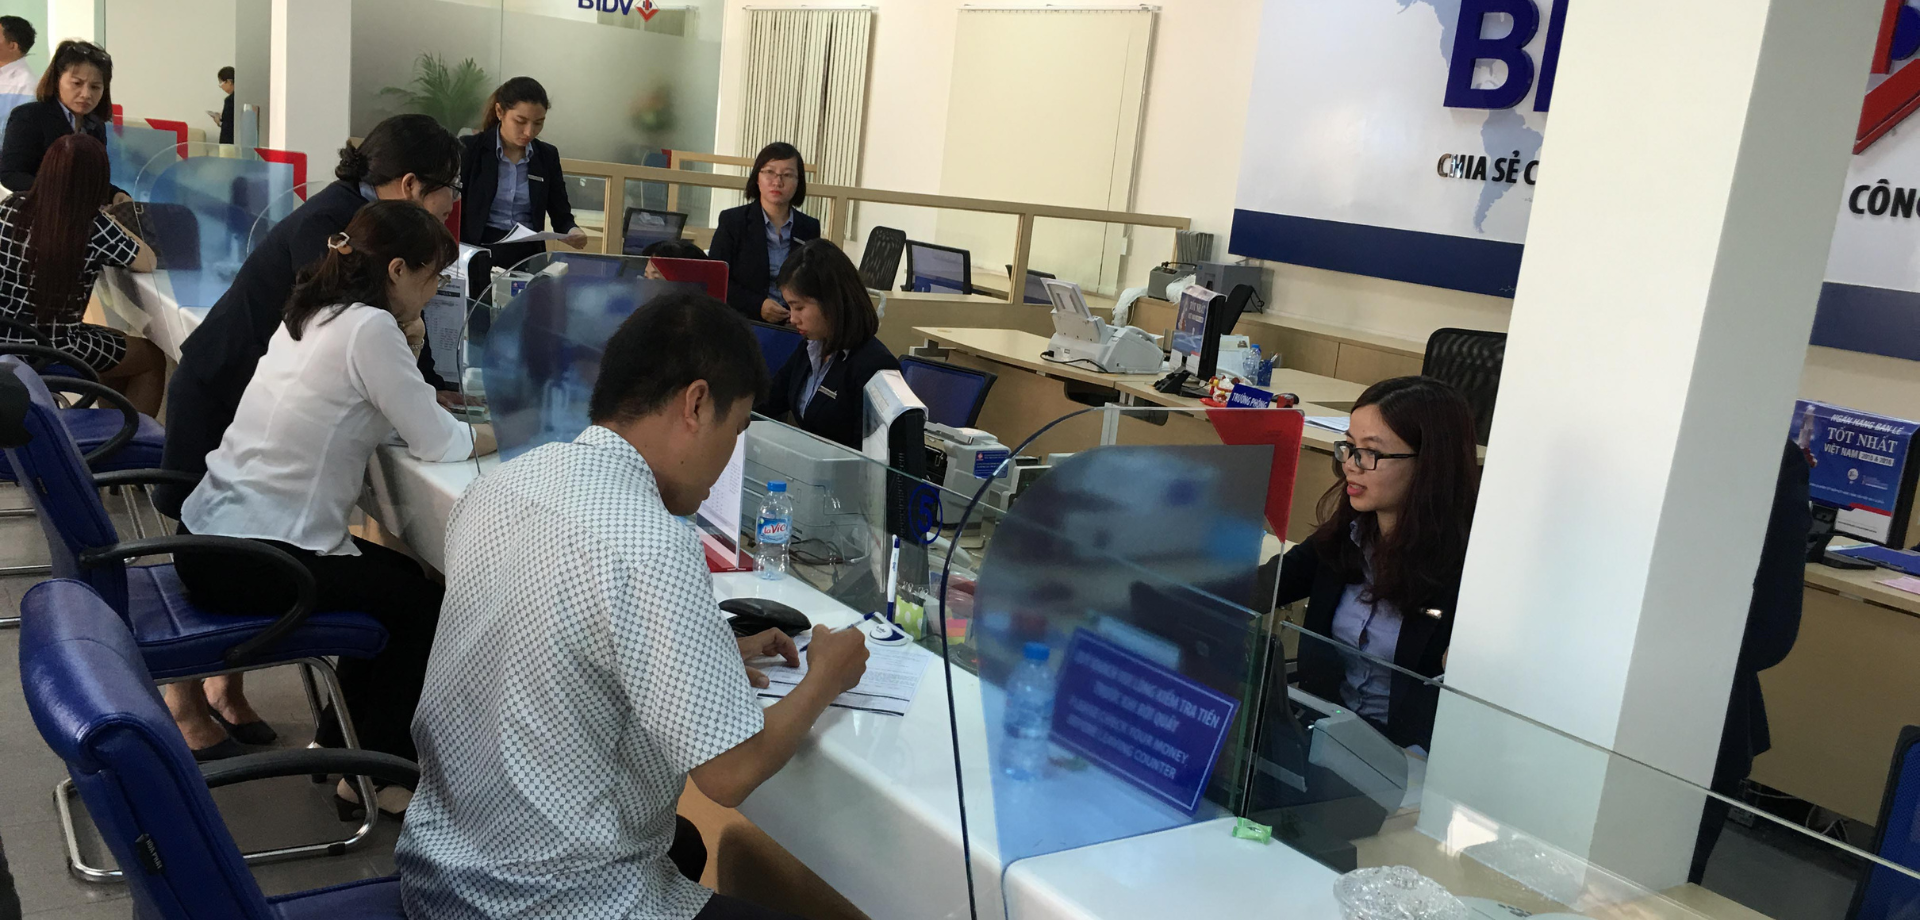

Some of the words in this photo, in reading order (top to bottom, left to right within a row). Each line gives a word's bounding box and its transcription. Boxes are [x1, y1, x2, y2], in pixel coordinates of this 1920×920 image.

[1437, 153, 1486, 181] CHIA
[1491, 150, 1520, 184] SẺ
[1848, 178, 1920, 218] CÔN
[1824, 442, 1840, 456] VIỆT
[1840, 447, 1858, 458] NAM
[1827, 425, 1855, 443] TỐT
[1856, 432, 1898, 453] NHẤT
[917, 494, 935, 532] 5
